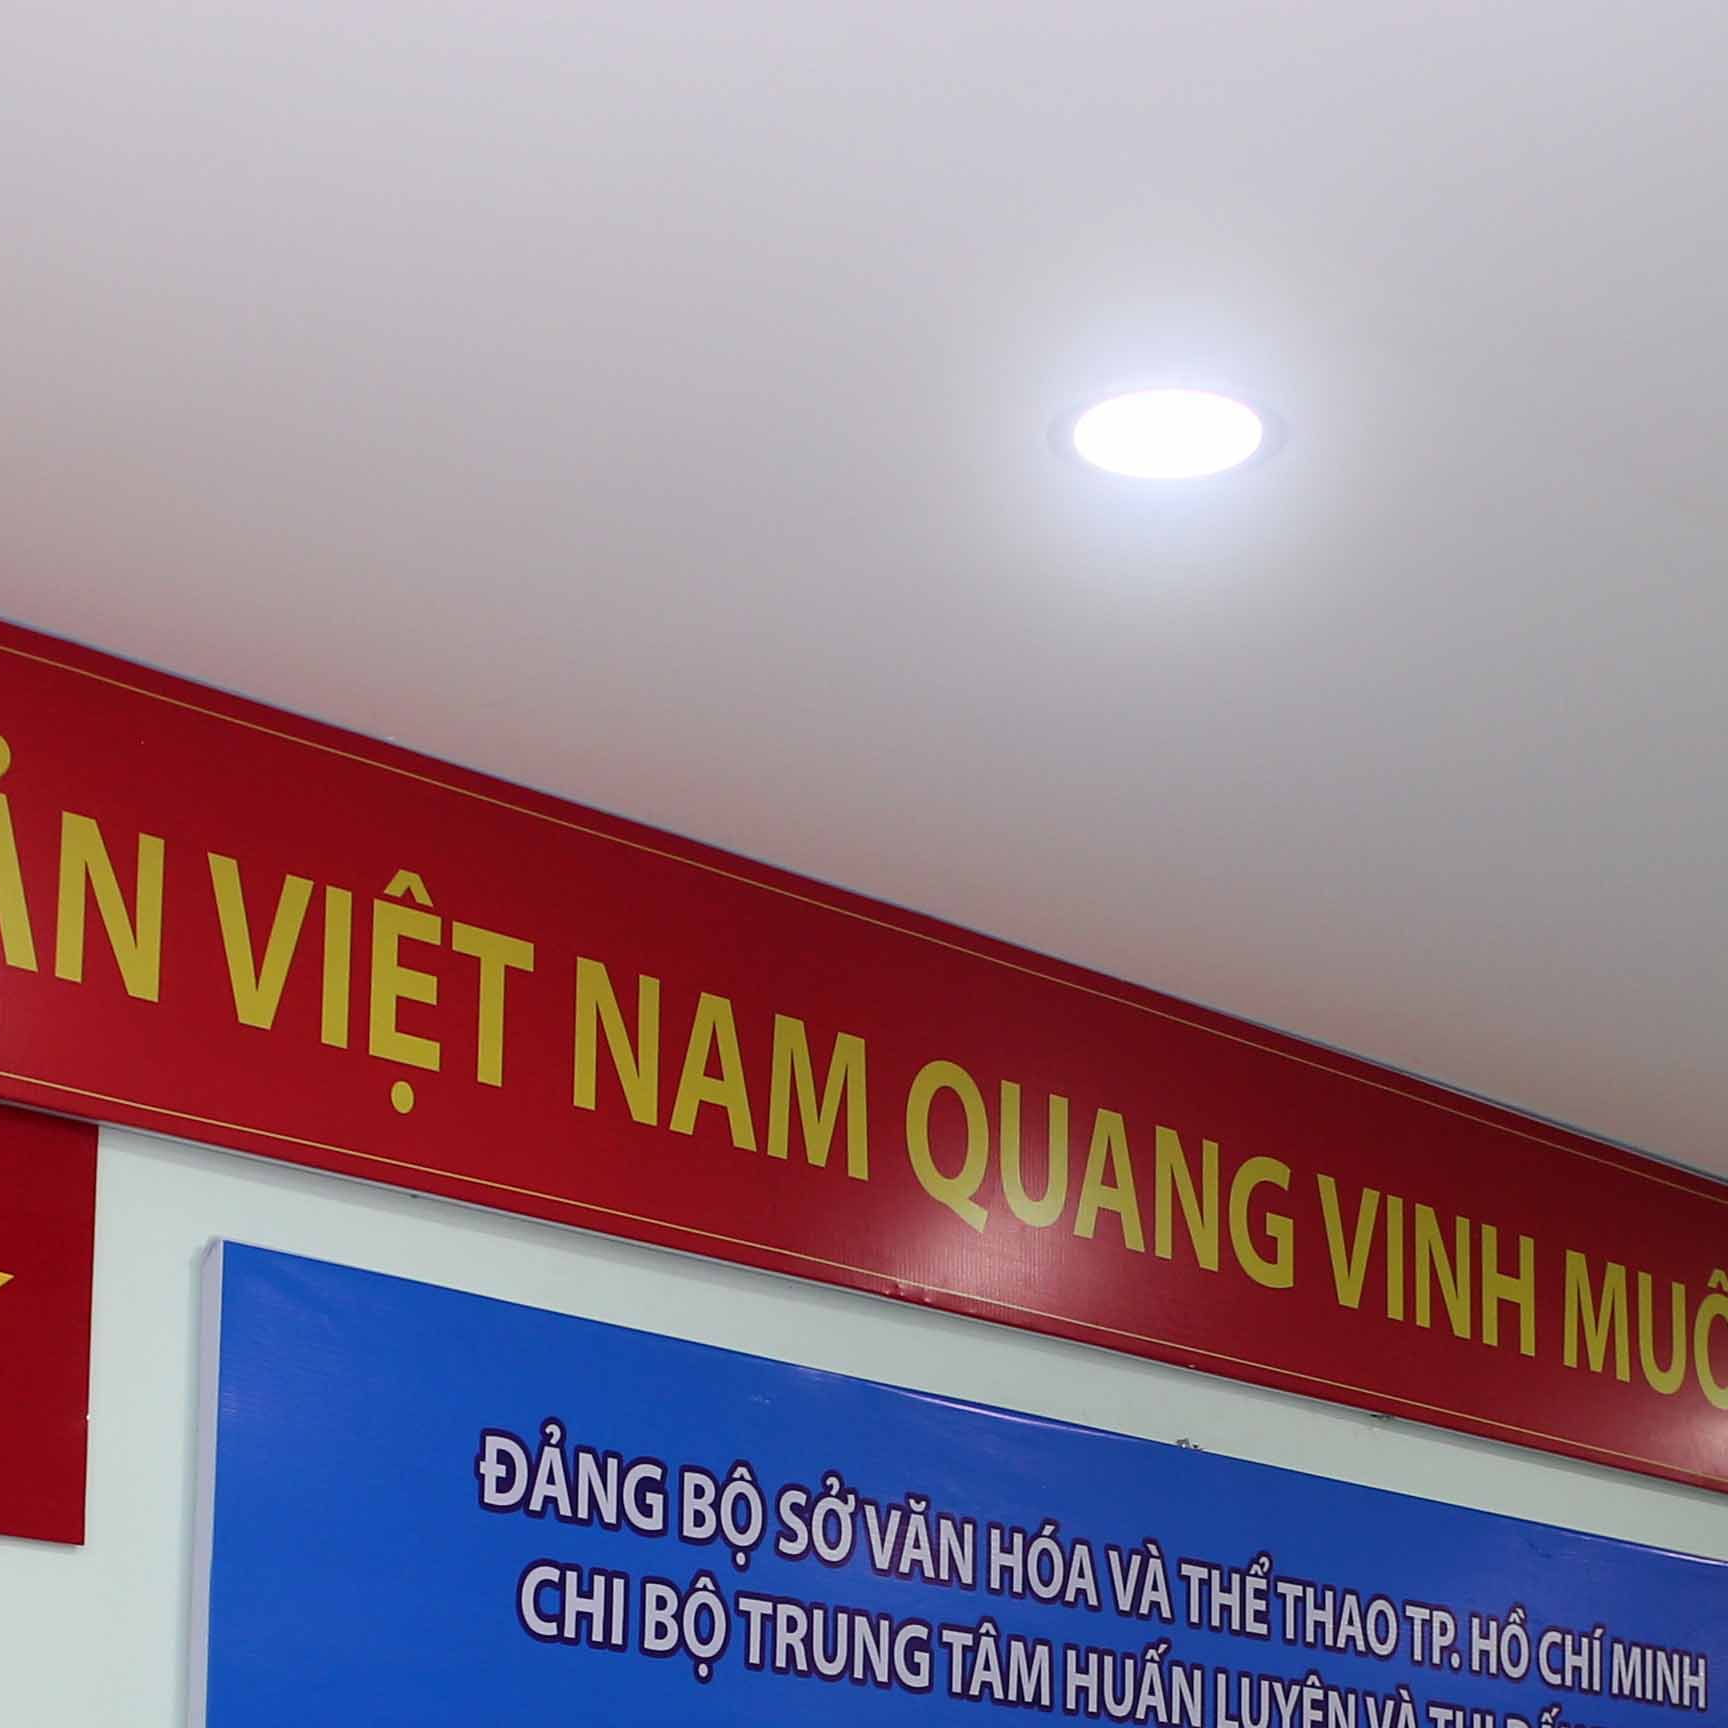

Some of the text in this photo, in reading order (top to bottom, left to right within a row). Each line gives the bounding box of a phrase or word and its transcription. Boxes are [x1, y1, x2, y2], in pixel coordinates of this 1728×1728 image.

[208, 855, 535, 1112] VIỆT
[574, 959, 870, 1180] NAM
[906, 1061, 1295, 1288] QUANG
[1317, 1176, 1536, 1355] VINH
[477, 1424, 1708, 1710] ĐẢNG BỘ SỞ VĂN HÓA VÀ THỂ THAO TP. HỒ CHÍ MINH
[519, 1564, 626, 1646] CHI
[642, 1576, 728, 1679] BỘ
[736, 1597, 931, 1689] TRUNG
[940, 1622, 1051, 1707] TÂM
[1065, 1641, 1203, 1728] HUẤN
